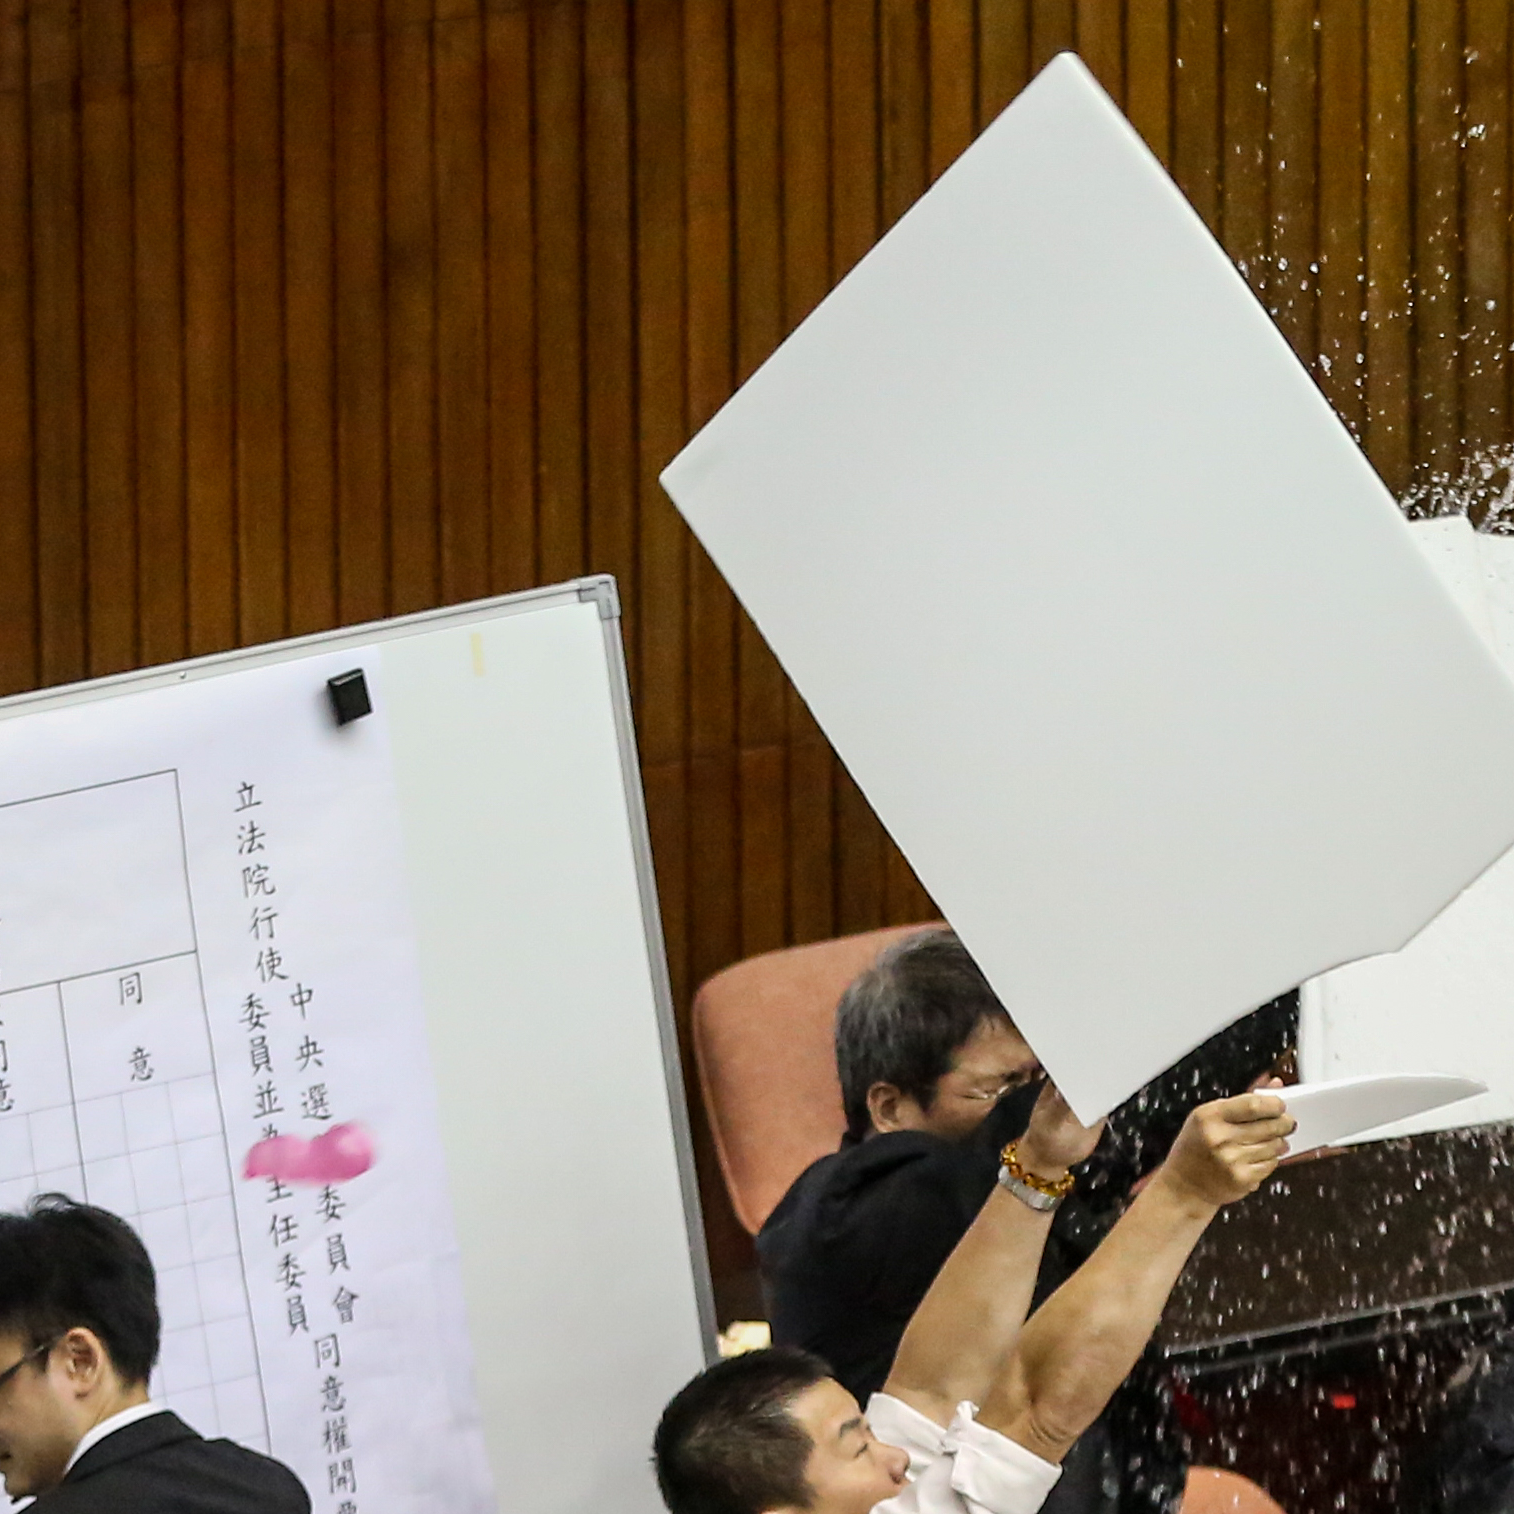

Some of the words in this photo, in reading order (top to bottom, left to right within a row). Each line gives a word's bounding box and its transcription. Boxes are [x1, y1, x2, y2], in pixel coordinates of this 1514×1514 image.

[118, 972, 155, 1082] 同意
[290, 982, 359, 1325] 中央選委員會
